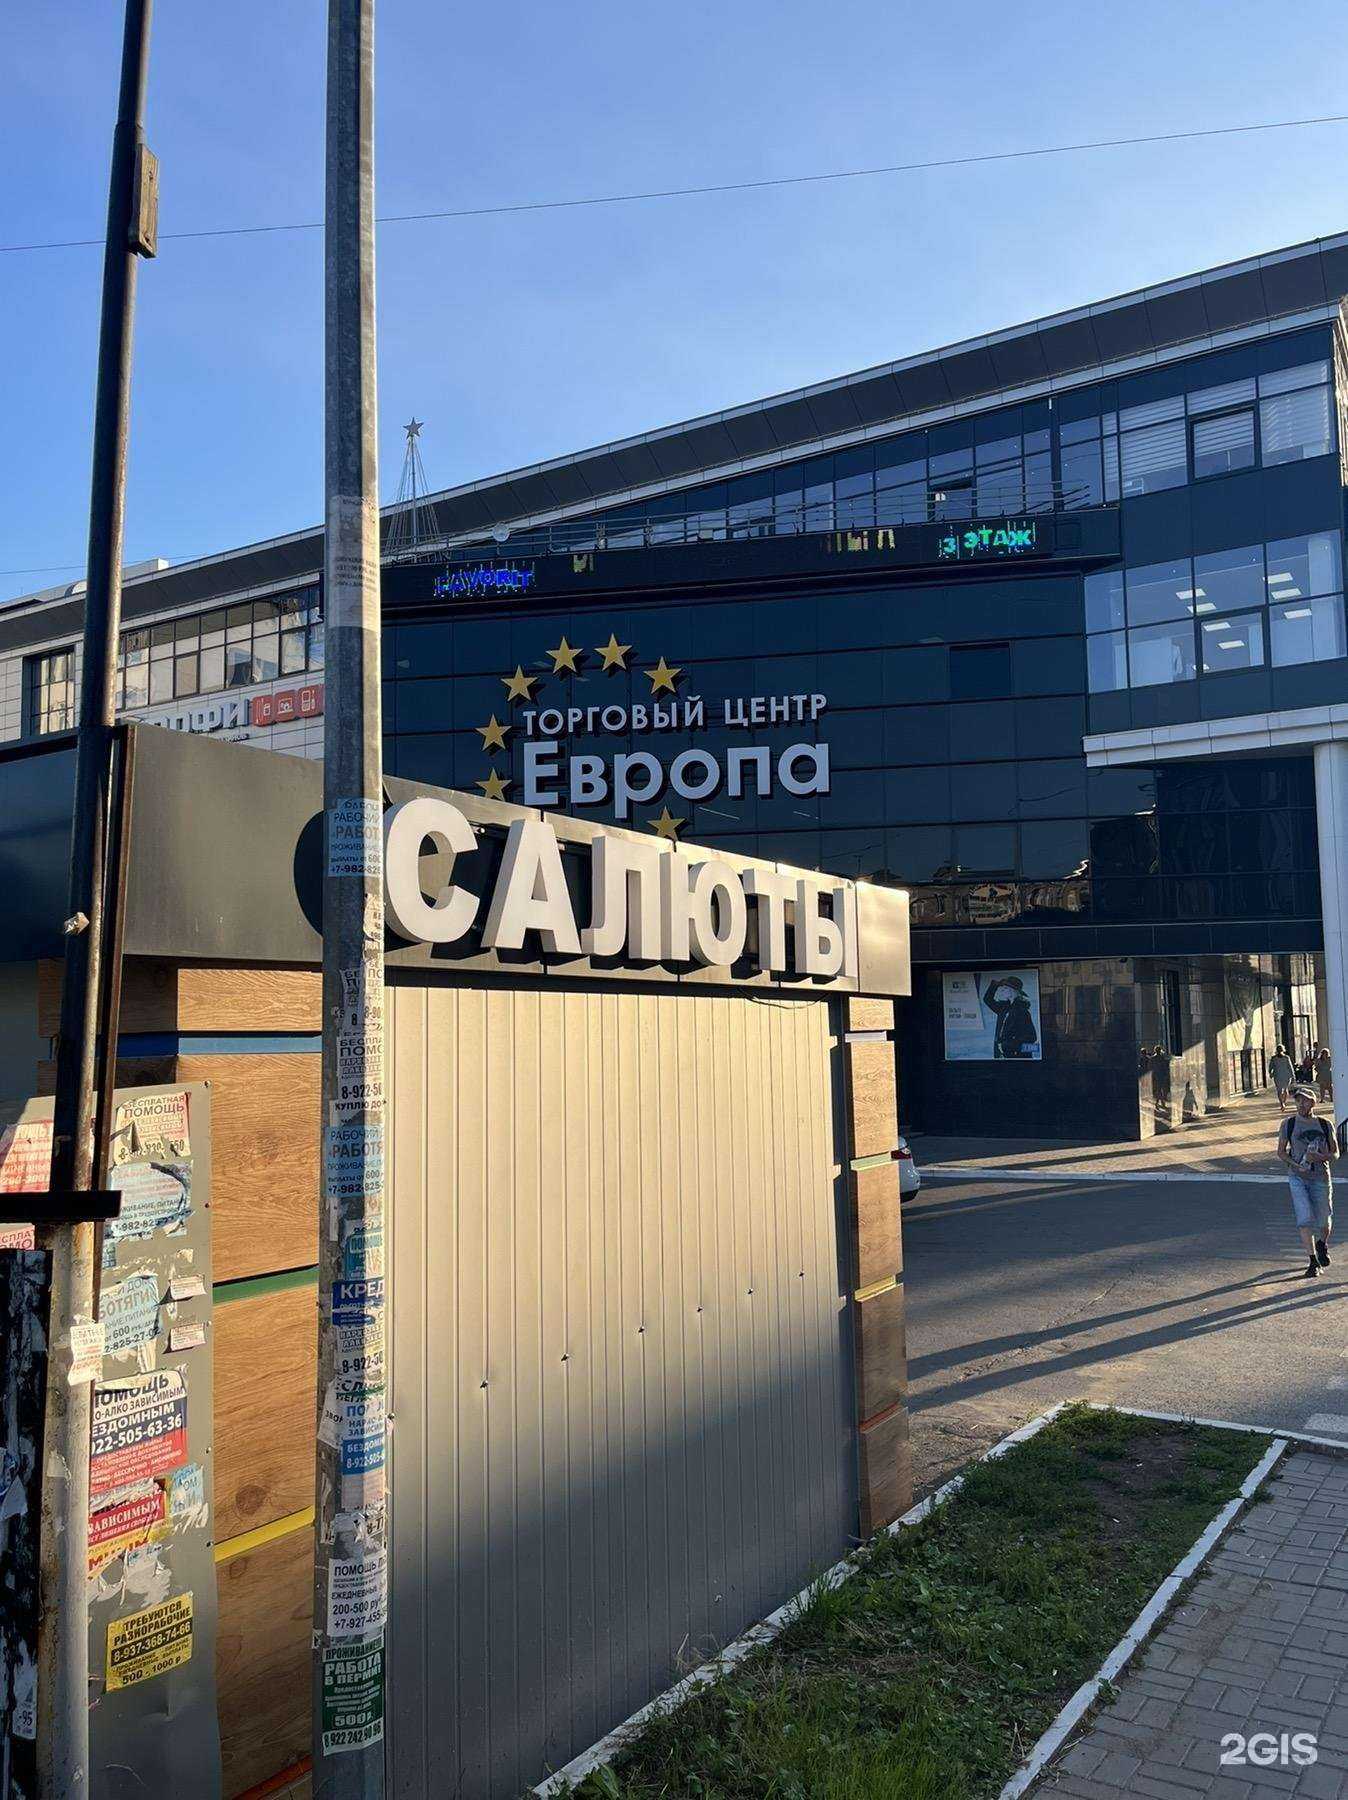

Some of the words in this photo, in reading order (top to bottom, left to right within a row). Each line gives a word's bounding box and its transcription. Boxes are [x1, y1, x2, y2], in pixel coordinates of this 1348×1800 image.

[963, 528, 1032, 549] ЭТАЖ
[523, 695, 703, 735] ТОРГОВЫЙ
[724, 694, 827, 727] ЦЕНТР
[523, 740, 830, 819] Европа
[384, 797, 859, 979] САЛЮТЫ
[124, 1104, 184, 1119] ПОМОЩЬ
[113, 1326, 130, 1339] 600
[334, 1562, 376, 1576] ПОМОЩЬ
[113, 1607, 191, 1647] РАЗНОРАБОЧИЕ
[124, 1600, 182, 1631] ТРЕБУЮТСЯ
[122, 1669, 144, 1685] 500
[152, 1659, 174, 1672] 1000
[325, 1651, 381, 1676] РАБОТА
[325, 1676, 334, 1686] В
